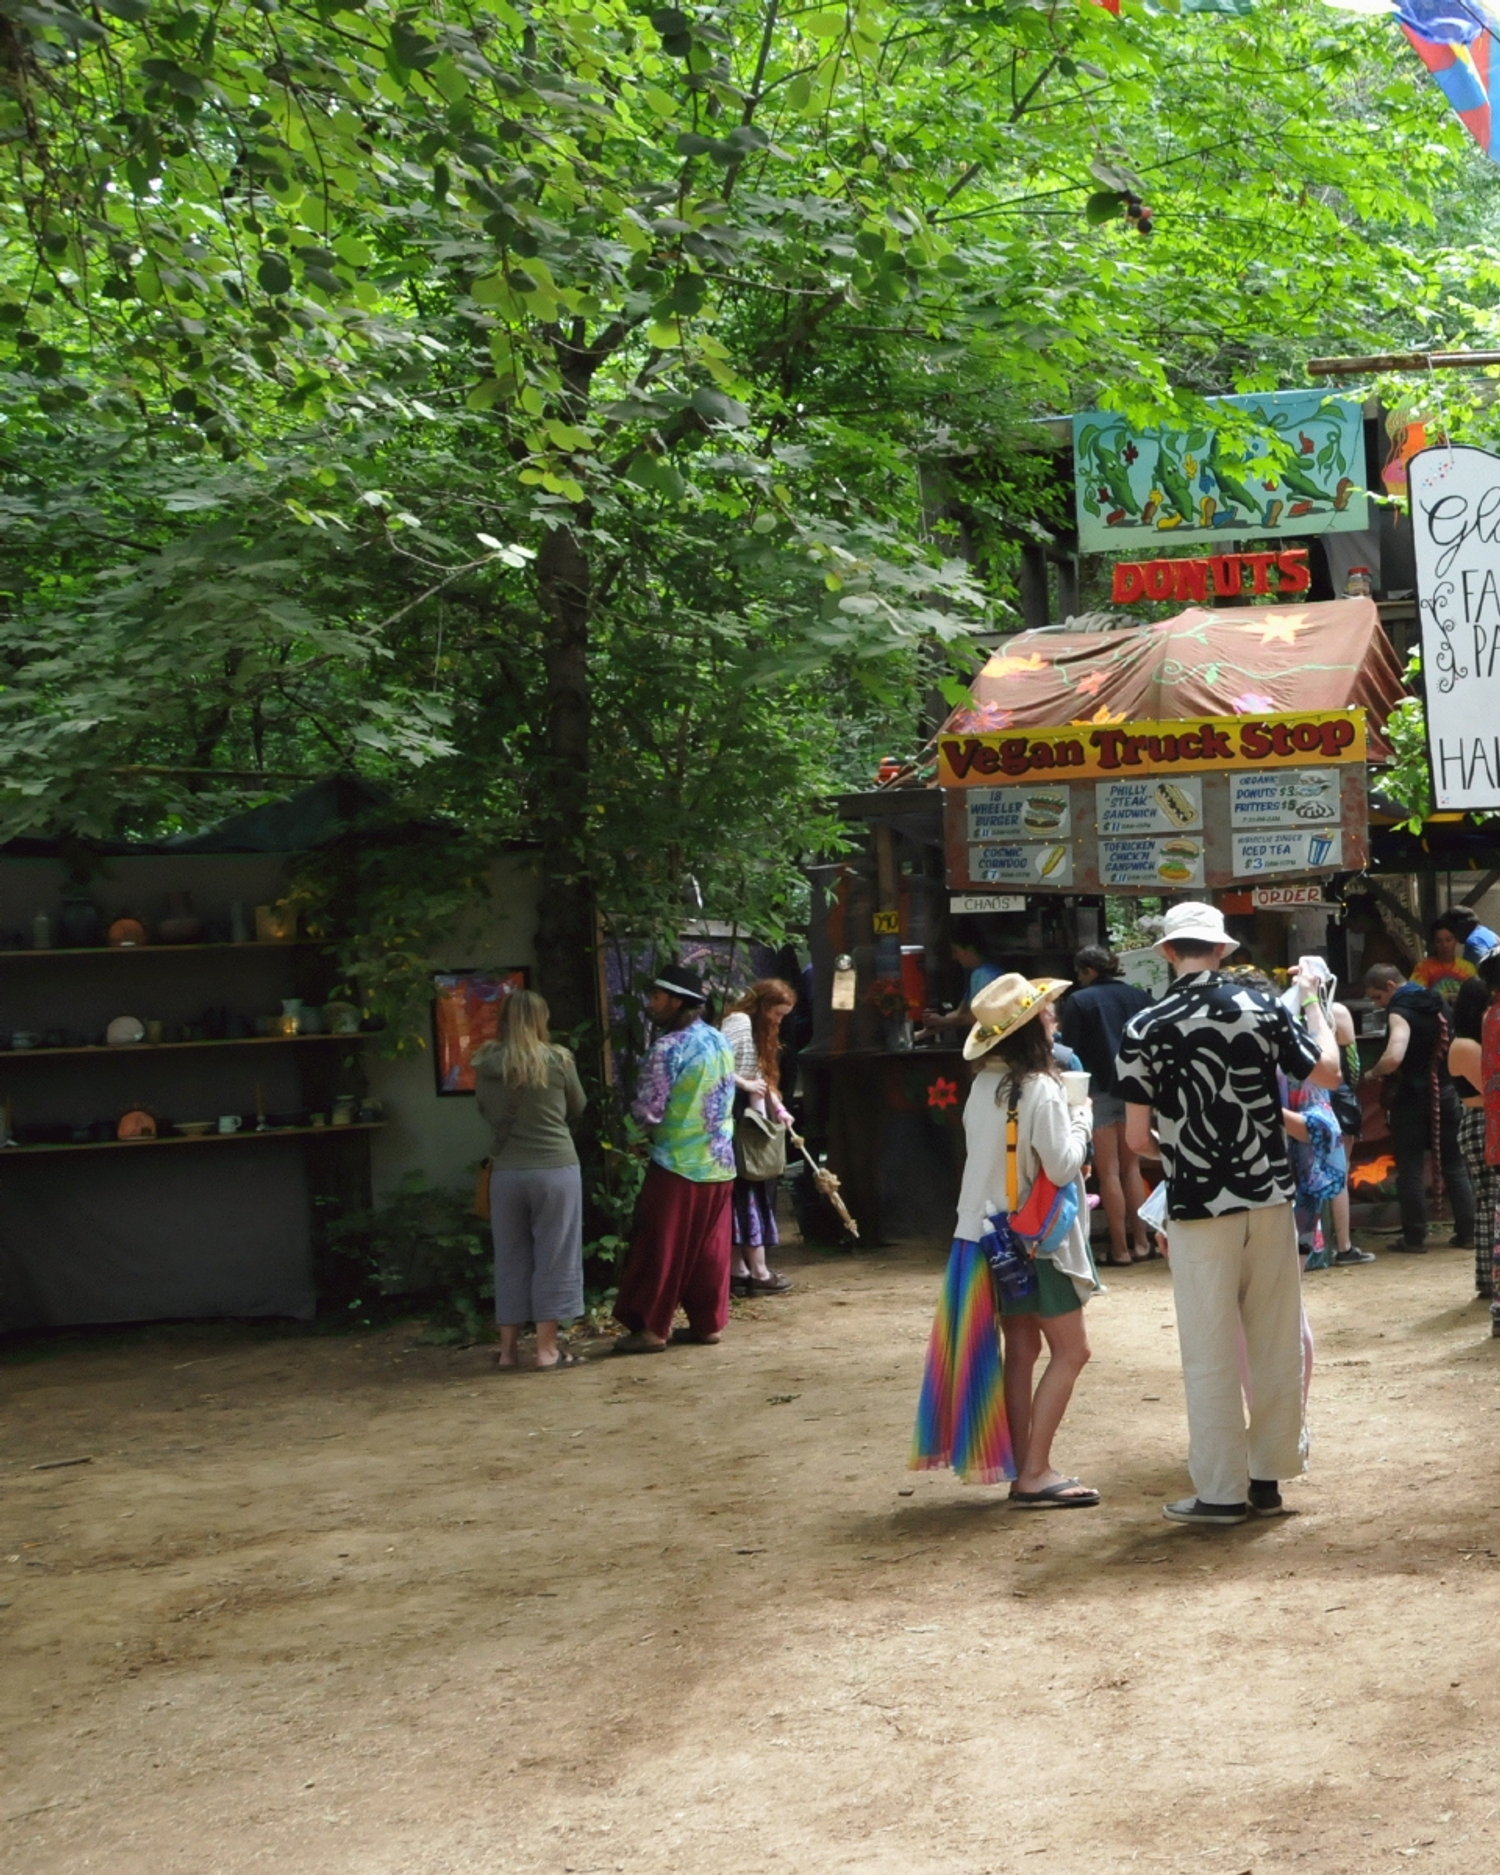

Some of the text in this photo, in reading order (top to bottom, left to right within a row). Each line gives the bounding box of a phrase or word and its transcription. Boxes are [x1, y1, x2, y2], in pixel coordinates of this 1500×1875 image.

[1112, 549, 1312, 604] DONUTS
[941, 717, 1355, 779] Vegan Truck Stop
[990, 791, 1002, 801] 18
[1109, 785, 1148, 796] PHILLY
[1236, 785, 1295, 799] DONUTS $3
[970, 802, 1023, 815] WHEELER
[1234, 799, 1297, 813] FRITTERS $5
[1102, 808, 1158, 820] SANDWICH
[975, 815, 1019, 827] BURGER
[983, 847, 1023, 858] COSMIC
[1242, 844, 1291, 856] ICED TEA
[978, 858, 1028, 868] CORNDOG
[1105, 861, 1156, 872] SANDWICH
[1258, 886, 1321, 905] ORDER
